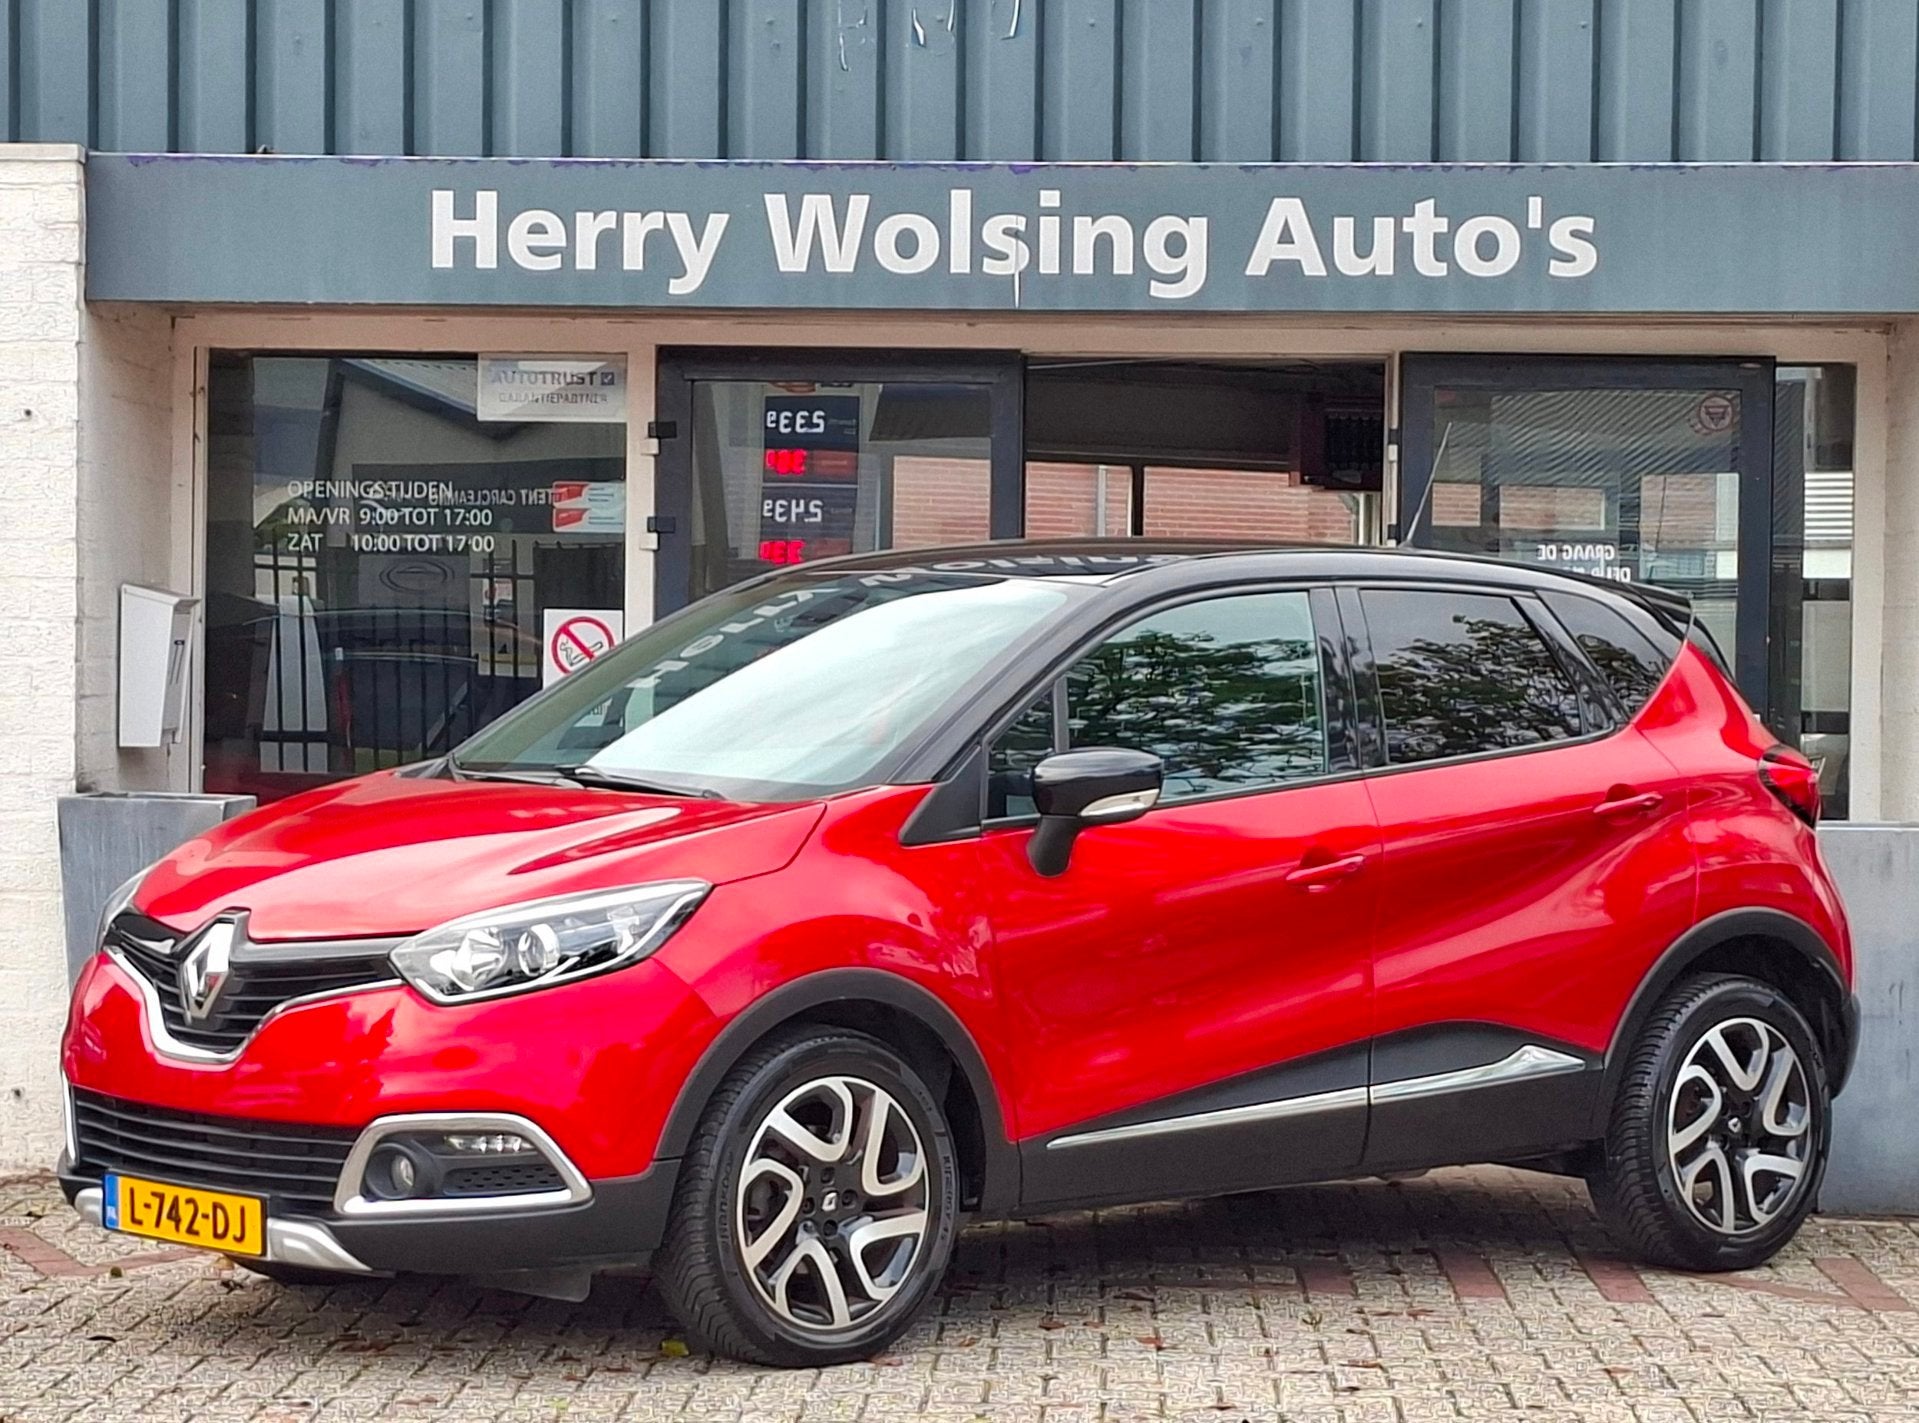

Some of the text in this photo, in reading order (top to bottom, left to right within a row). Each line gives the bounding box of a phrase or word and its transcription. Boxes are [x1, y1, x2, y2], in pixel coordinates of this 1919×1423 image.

[431, 189, 1598, 299] Herry Wolsing Auto's
[491, 371, 597, 386] AUTOTRUST
[287, 480, 453, 499] OPENINGSTIJDEN
[288, 508, 493, 526] MA/VR 9:00 TOT 17:00
[288, 533, 323, 551] ZAT
[351, 534, 400, 552] 10:00
[402, 534, 440, 552] TOT
[129, 1187, 246, 1243] L-742-DJ
